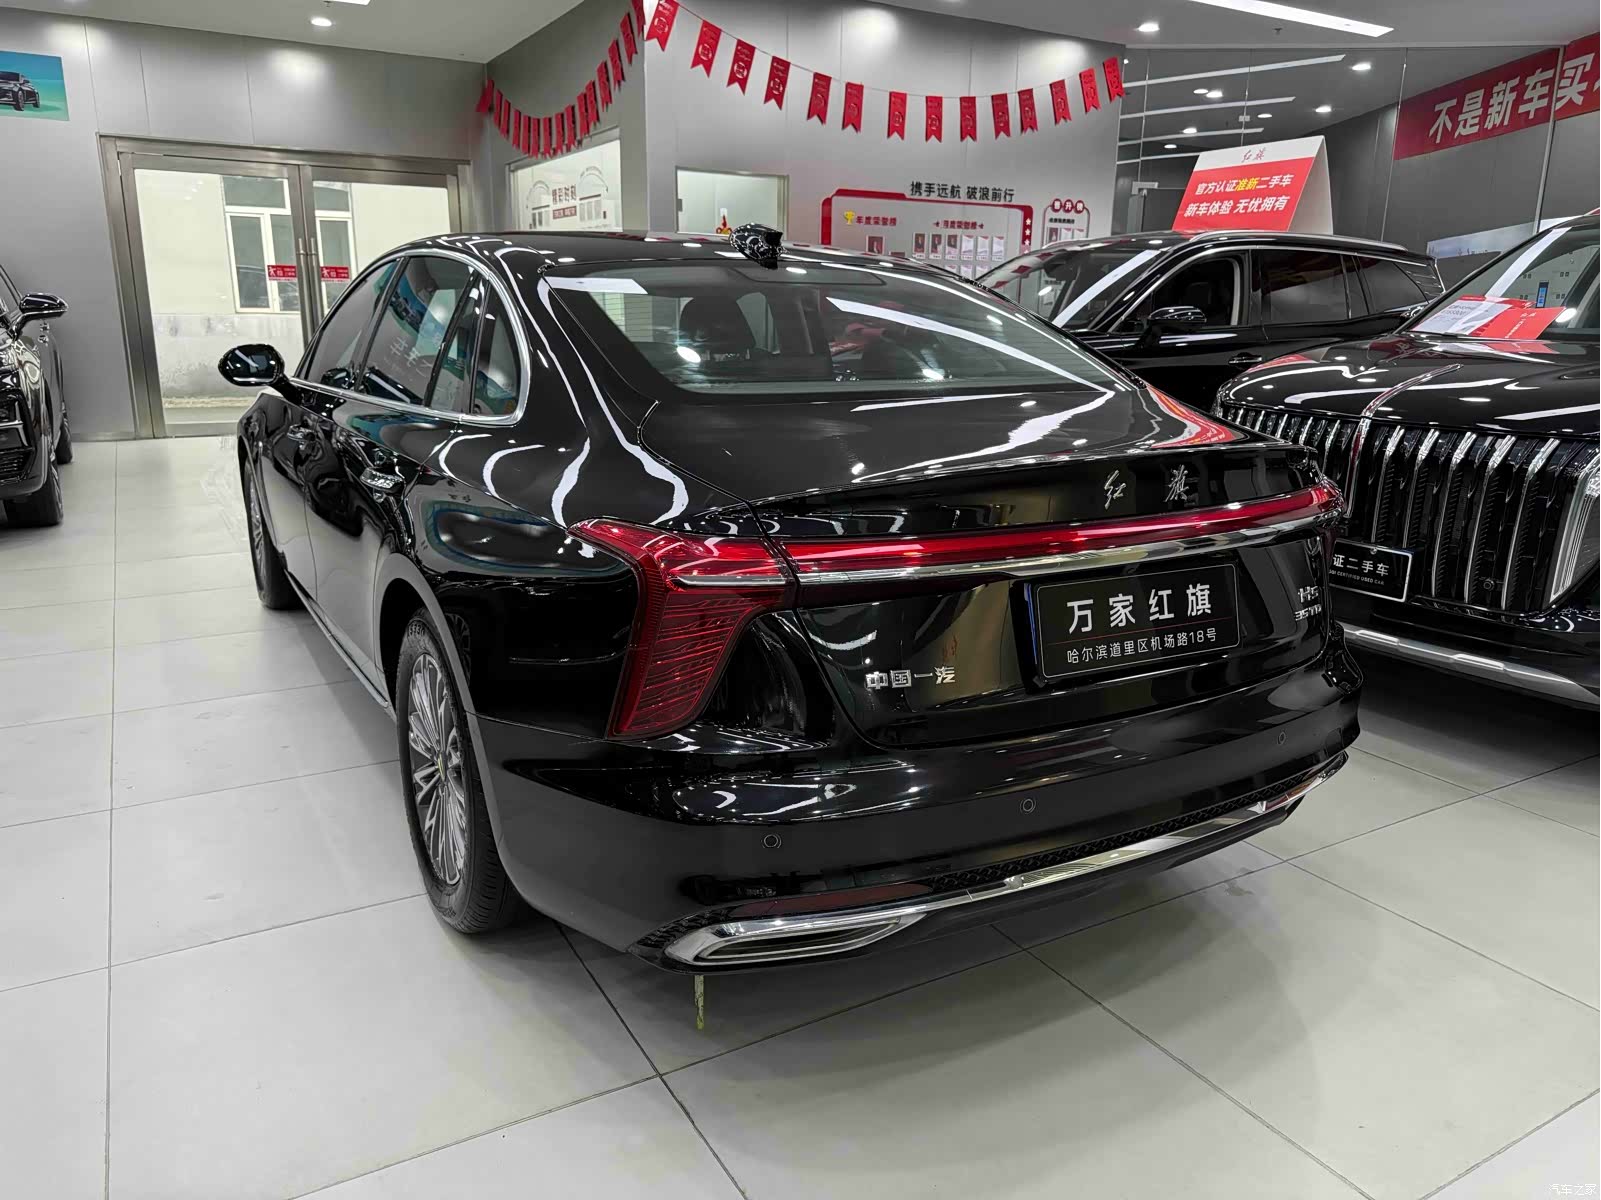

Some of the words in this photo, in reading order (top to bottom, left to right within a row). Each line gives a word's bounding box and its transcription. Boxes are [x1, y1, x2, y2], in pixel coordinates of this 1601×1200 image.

[1429, 52, 1600, 144] 不是新车买
[910, 181, 962, 199] 携手远航
[966, 185, 1015, 202] 破浪前行
[1195, 174, 1293, 195] 官方认证准新二手车
[1184, 200, 1234, 217] 新车体验
[1233, 194, 1290, 214] 无忧拥有
[1337, 571, 1360, 580] CERTIFIED
[1360, 576, 1374, 584] USED
[1066, 583, 1212, 634] 万家红旗
[1066, 627, 1217, 664] 哈尔滨道里区机场路18号
[865, 666, 956, 690] 中国一汽
